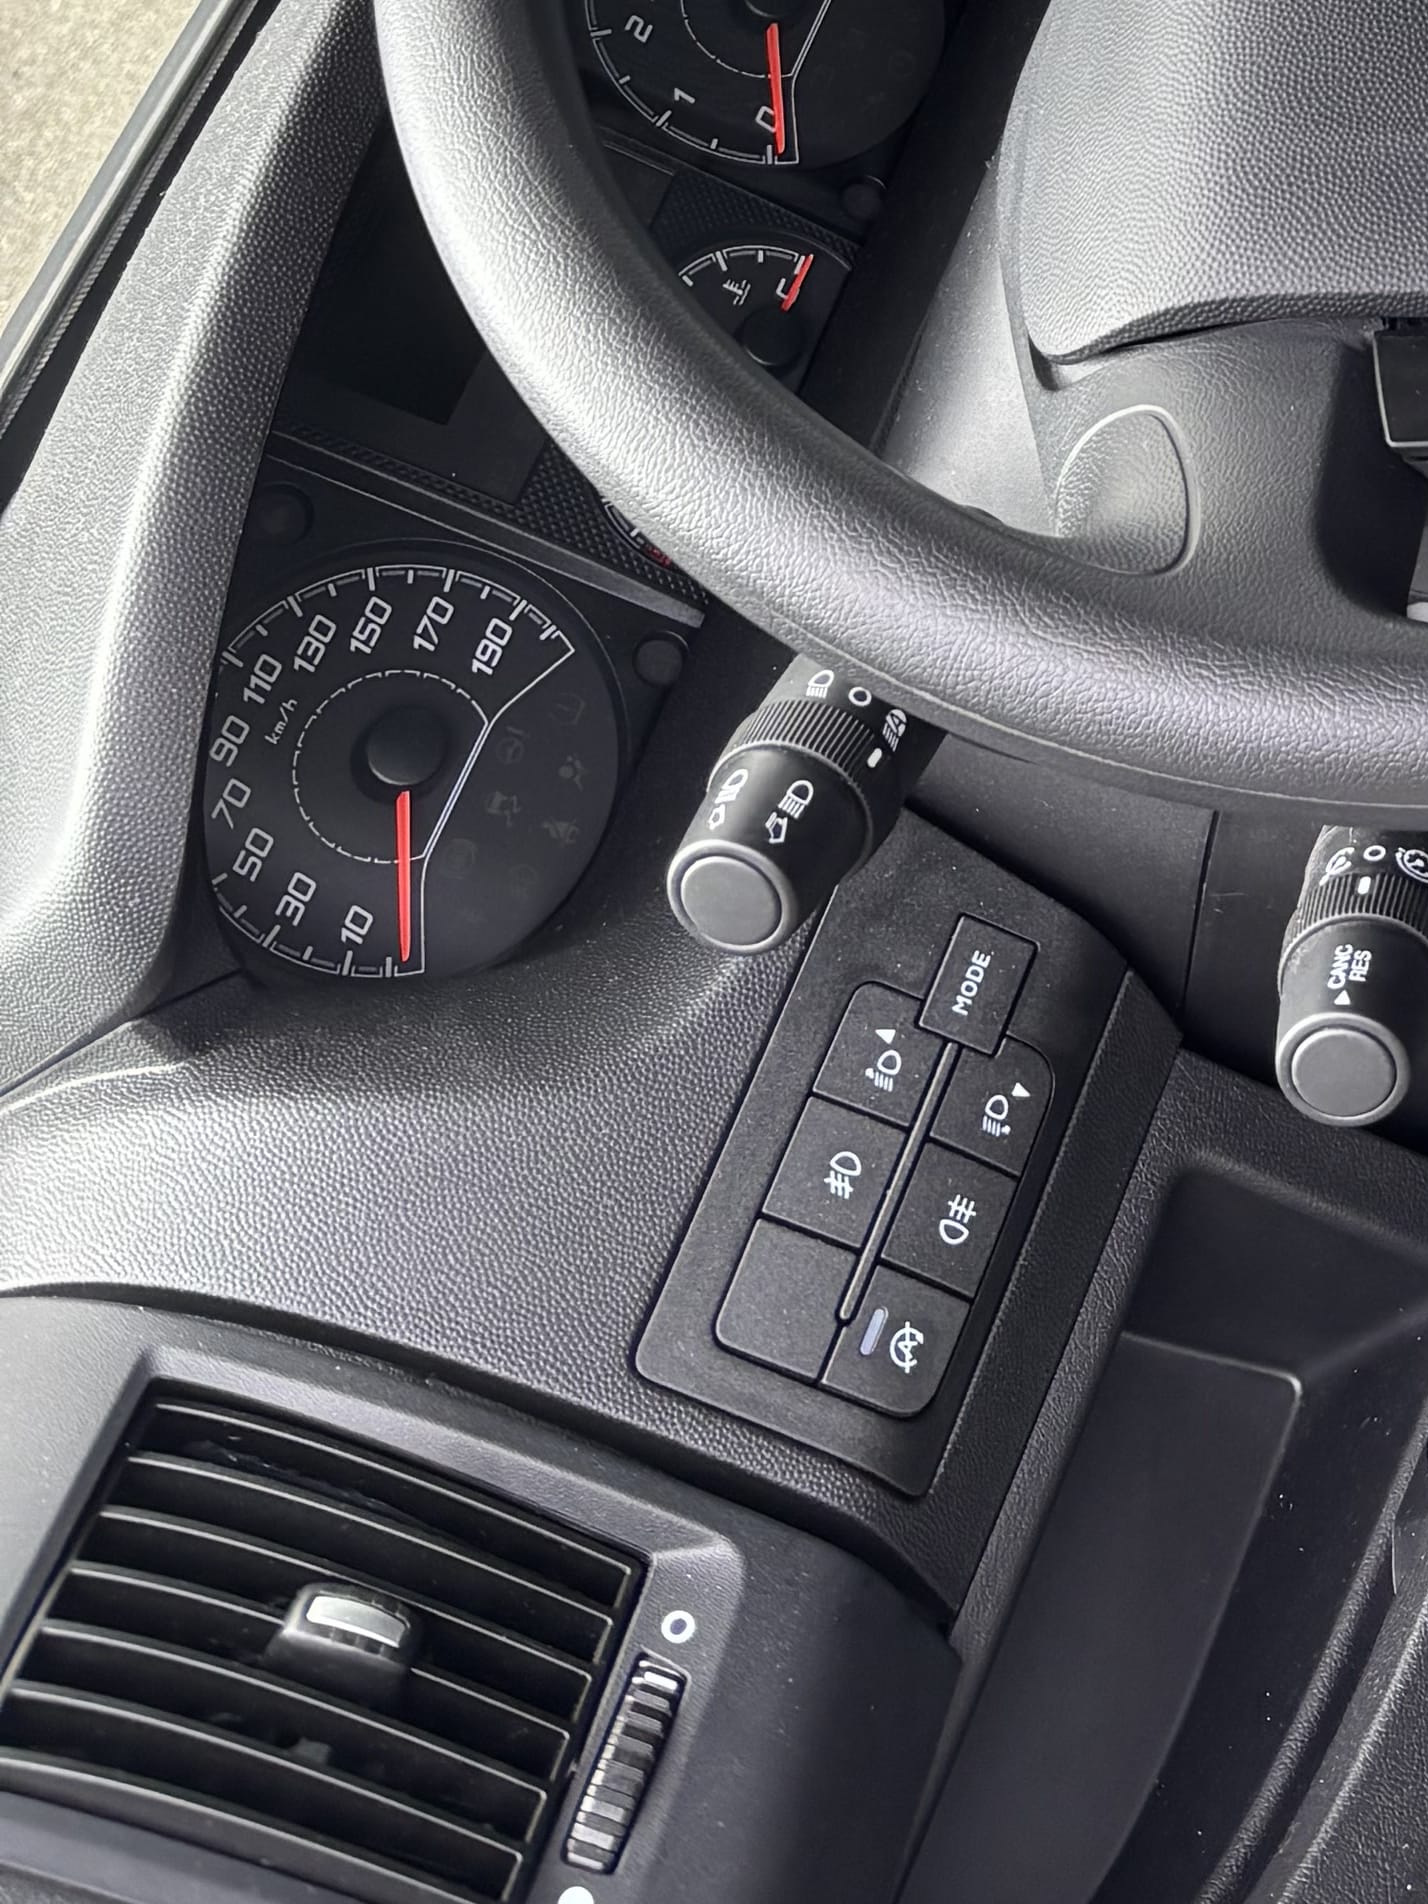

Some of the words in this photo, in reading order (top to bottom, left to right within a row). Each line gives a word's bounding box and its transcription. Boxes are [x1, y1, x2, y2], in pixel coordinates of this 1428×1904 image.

[625, 14, 653, 43] 2
[673, 87, 696, 106] 1
[293, 614, 337, 673] 130
[349, 596, 393, 655] 150
[412, 595, 455, 652] 170
[471, 617, 513, 676] 190
[243, 654, 283, 705] 110
[209, 714, 250, 767] 90
[265, 697, 298, 744] km/h
[211, 778, 251, 829] 70
[232, 827, 275, 882] 50
[275, 872, 317, 927] 30
[340, 904, 374, 945] 10
[951, 950, 992, 1016] MODE
[1327, 944, 1353, 989] CANC
[1348, 950, 1372, 982] RES
